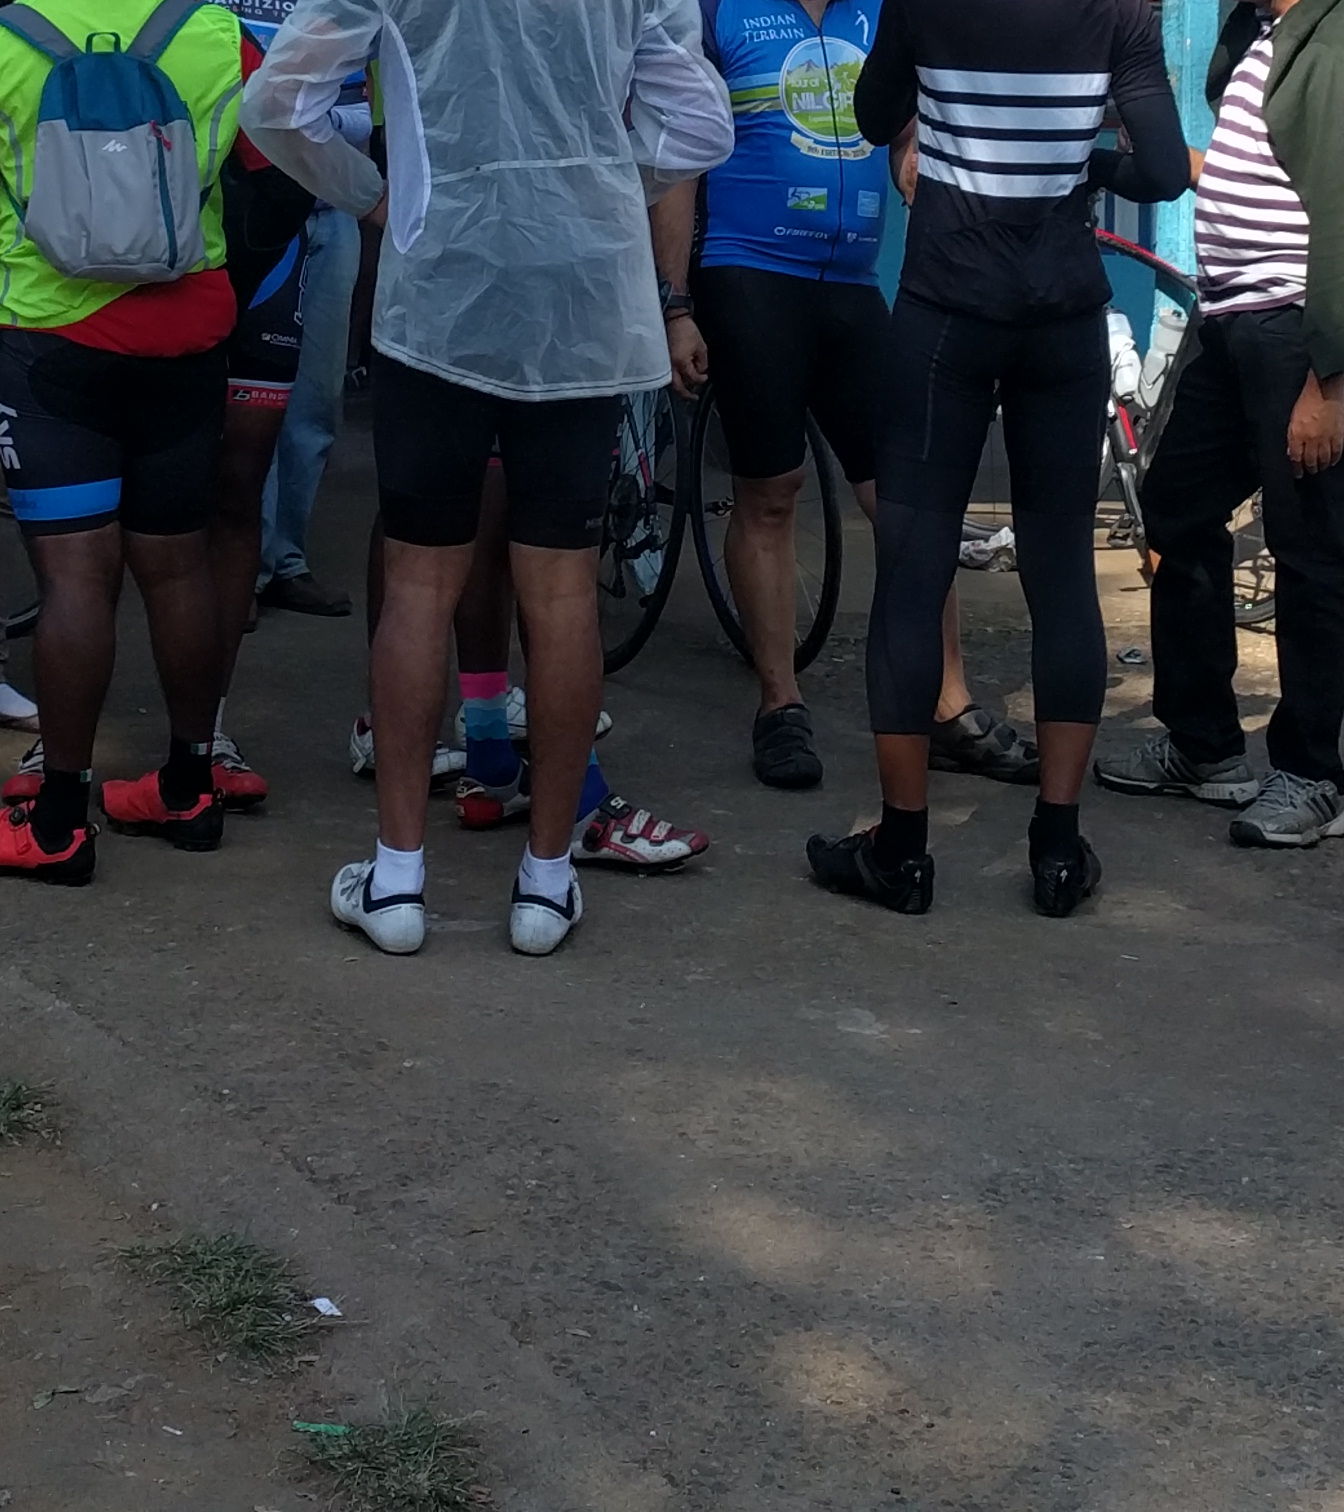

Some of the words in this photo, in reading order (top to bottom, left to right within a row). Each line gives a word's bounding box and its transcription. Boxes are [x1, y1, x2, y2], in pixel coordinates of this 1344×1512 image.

[743, 14, 796, 29] INDIAN
[742, 28, 805, 43] TERRAIN
[791, 91, 856, 113] NILGIR
